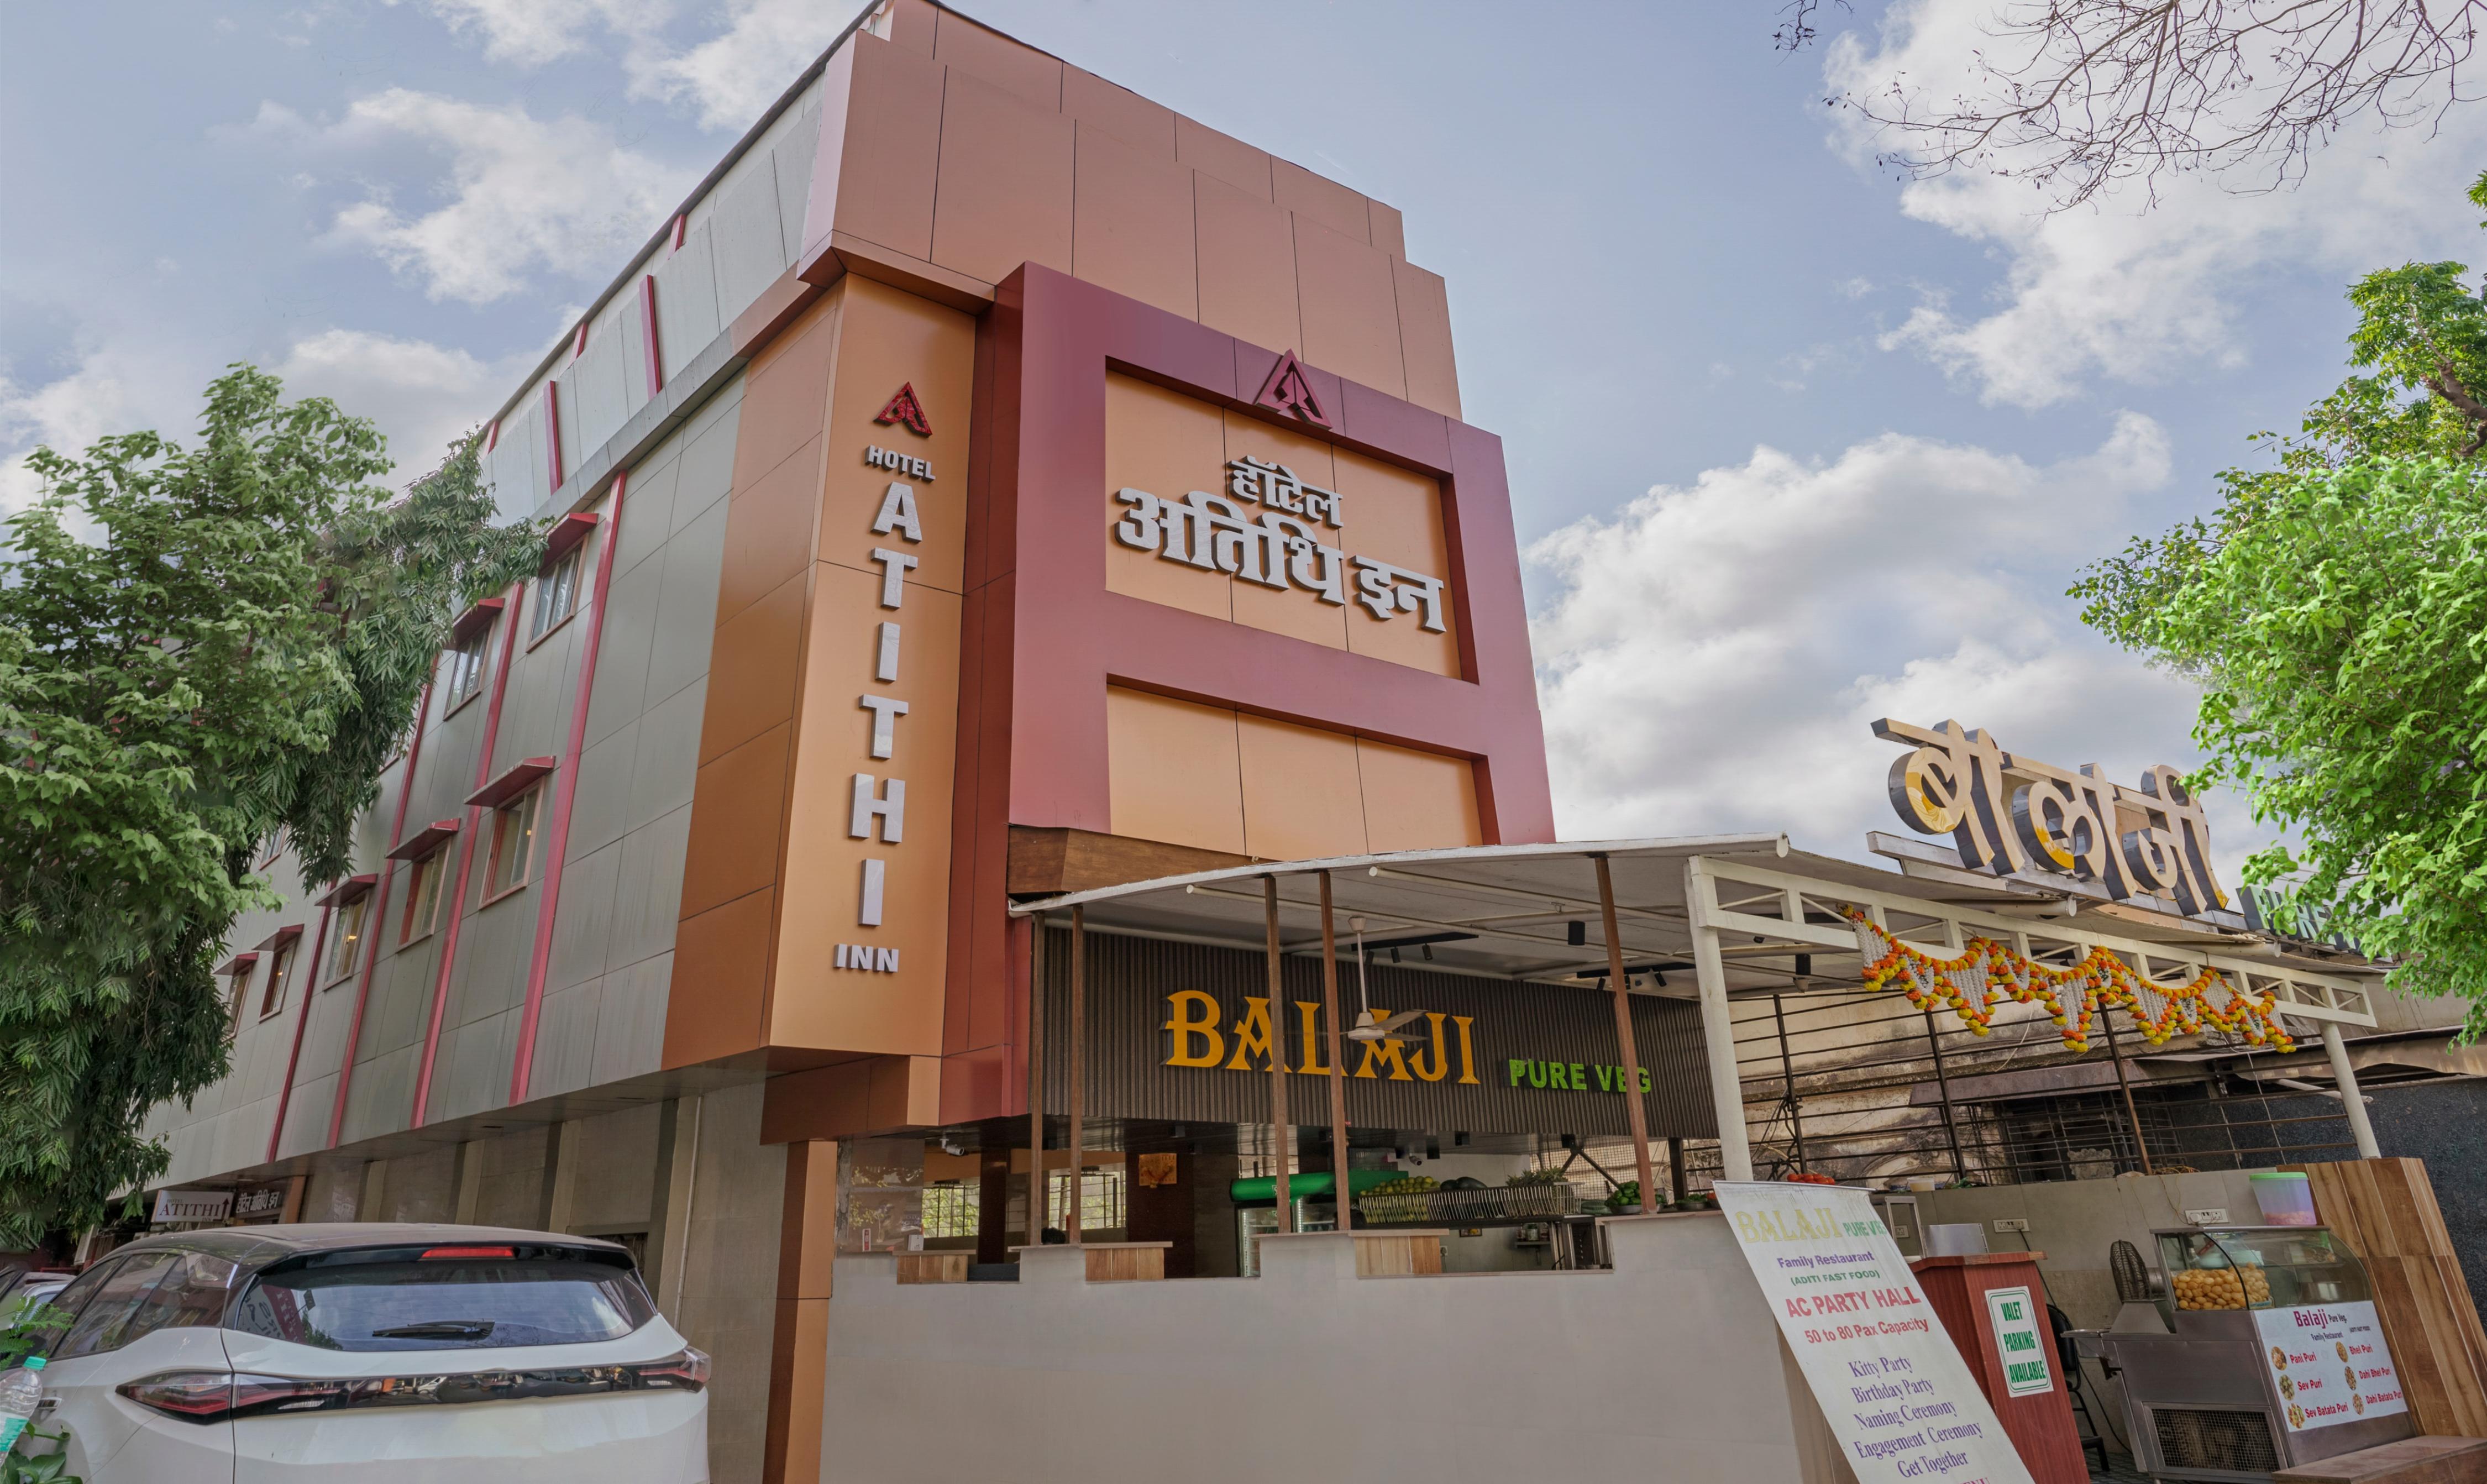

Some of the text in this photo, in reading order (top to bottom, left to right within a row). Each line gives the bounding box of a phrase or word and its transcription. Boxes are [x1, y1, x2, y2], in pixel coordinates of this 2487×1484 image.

[865, 445, 936, 482] HOTEL
[1226, 455, 1343, 529] हॉटेल
[1115, 487, 1447, 633] अतिथि इन
[848, 481, 922, 927] ATITHI
[833, 944, 899, 973] INN
[1507, 1058, 1652, 1093] PURE VEG
[159, 1203, 219, 1216] ATITHI
[1735, 1208, 1843, 1243] BALAJI
[1843, 1221, 1871, 1237] PURE
[1777, 1251, 1875, 1268] Family Restaurant
[1791, 1270, 1881, 1286] (ADITI FAST FOOD)
[1786, 1286, 1922, 1318] AC PARTY HALL
[2000, 1301, 2023, 1322] VALET
[2293, 1309, 2328, 1329] Balaji
[2328, 1314, 2338, 1323] Pure
[1804, 1318, 1929, 1344] 50 to 80 Pax Capacity
[2003, 1330, 2036, 1352] PARKING
[2311, 1331, 2344, 1342] Family Restaurant
[2289, 1351, 2317, 1364] Pani Puri
[2349, 1344, 2374, 1355] Bhel Puri
[1848, 1356, 1913, 1379] Kitty Party
[2008, 1360, 2047, 1384] AVAILABLE
[2359, 1366, 2391, 1380] Dahi Bhel Puri
[1850, 1378, 1934, 1403] Birthday Party
[2297, 1378, 2323, 1391] Sev Puri
[2365, 1394, 2378, 1404] Dahi
[2378, 1392, 2394, 1403] Batata
[1853, 1402, 1958, 1430] Naming Ceremony
[2305, 1402, 2349, 1418] Sev Batata Puri
[1853, 1423, 1984, 1460] Engagement Ceremony
[1897, 1451, 1969, 1478] Get Together
